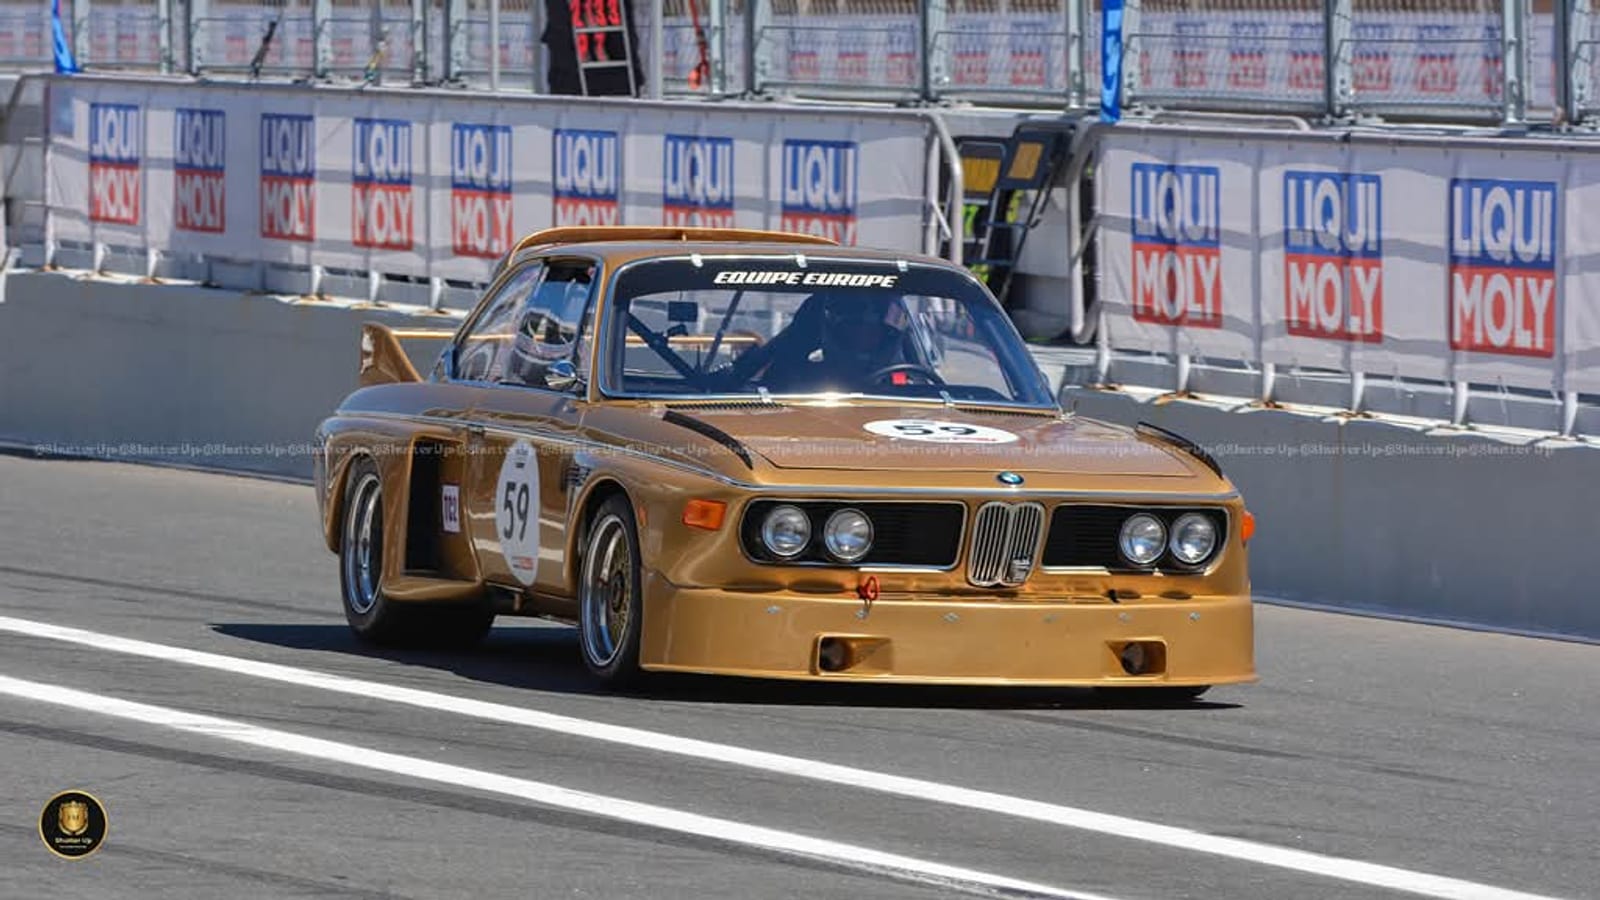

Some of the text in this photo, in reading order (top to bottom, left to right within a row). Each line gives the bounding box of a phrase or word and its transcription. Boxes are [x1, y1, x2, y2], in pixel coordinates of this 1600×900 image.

[177, 113, 223, 167] LIQUI
[263, 119, 314, 174] LIQUI
[355, 124, 410, 179] LIQUI
[454, 129, 509, 187] LIQUI
[556, 135, 616, 195] LIQUI
[176, 175, 223, 227] MOLY
[667, 141, 731, 203] LIQUI
[786, 146, 856, 209] LIQUI
[264, 180, 314, 235] MOLY
[354, 189, 411, 244] MOLY
[1135, 171, 1216, 242] LIQUI
[1288, 179, 1377, 252] LIQUI
[1453, 186, 1552, 264] LIQUI
[714, 271, 898, 288] EQUIPE EUROPE
[1136, 251, 1219, 320] MOLY
[1289, 262, 1380, 334] MOLY
[1453, 273, 1553, 349] MOLY
[893, 425, 977, 436] 59
[503, 481, 530, 541] 59
